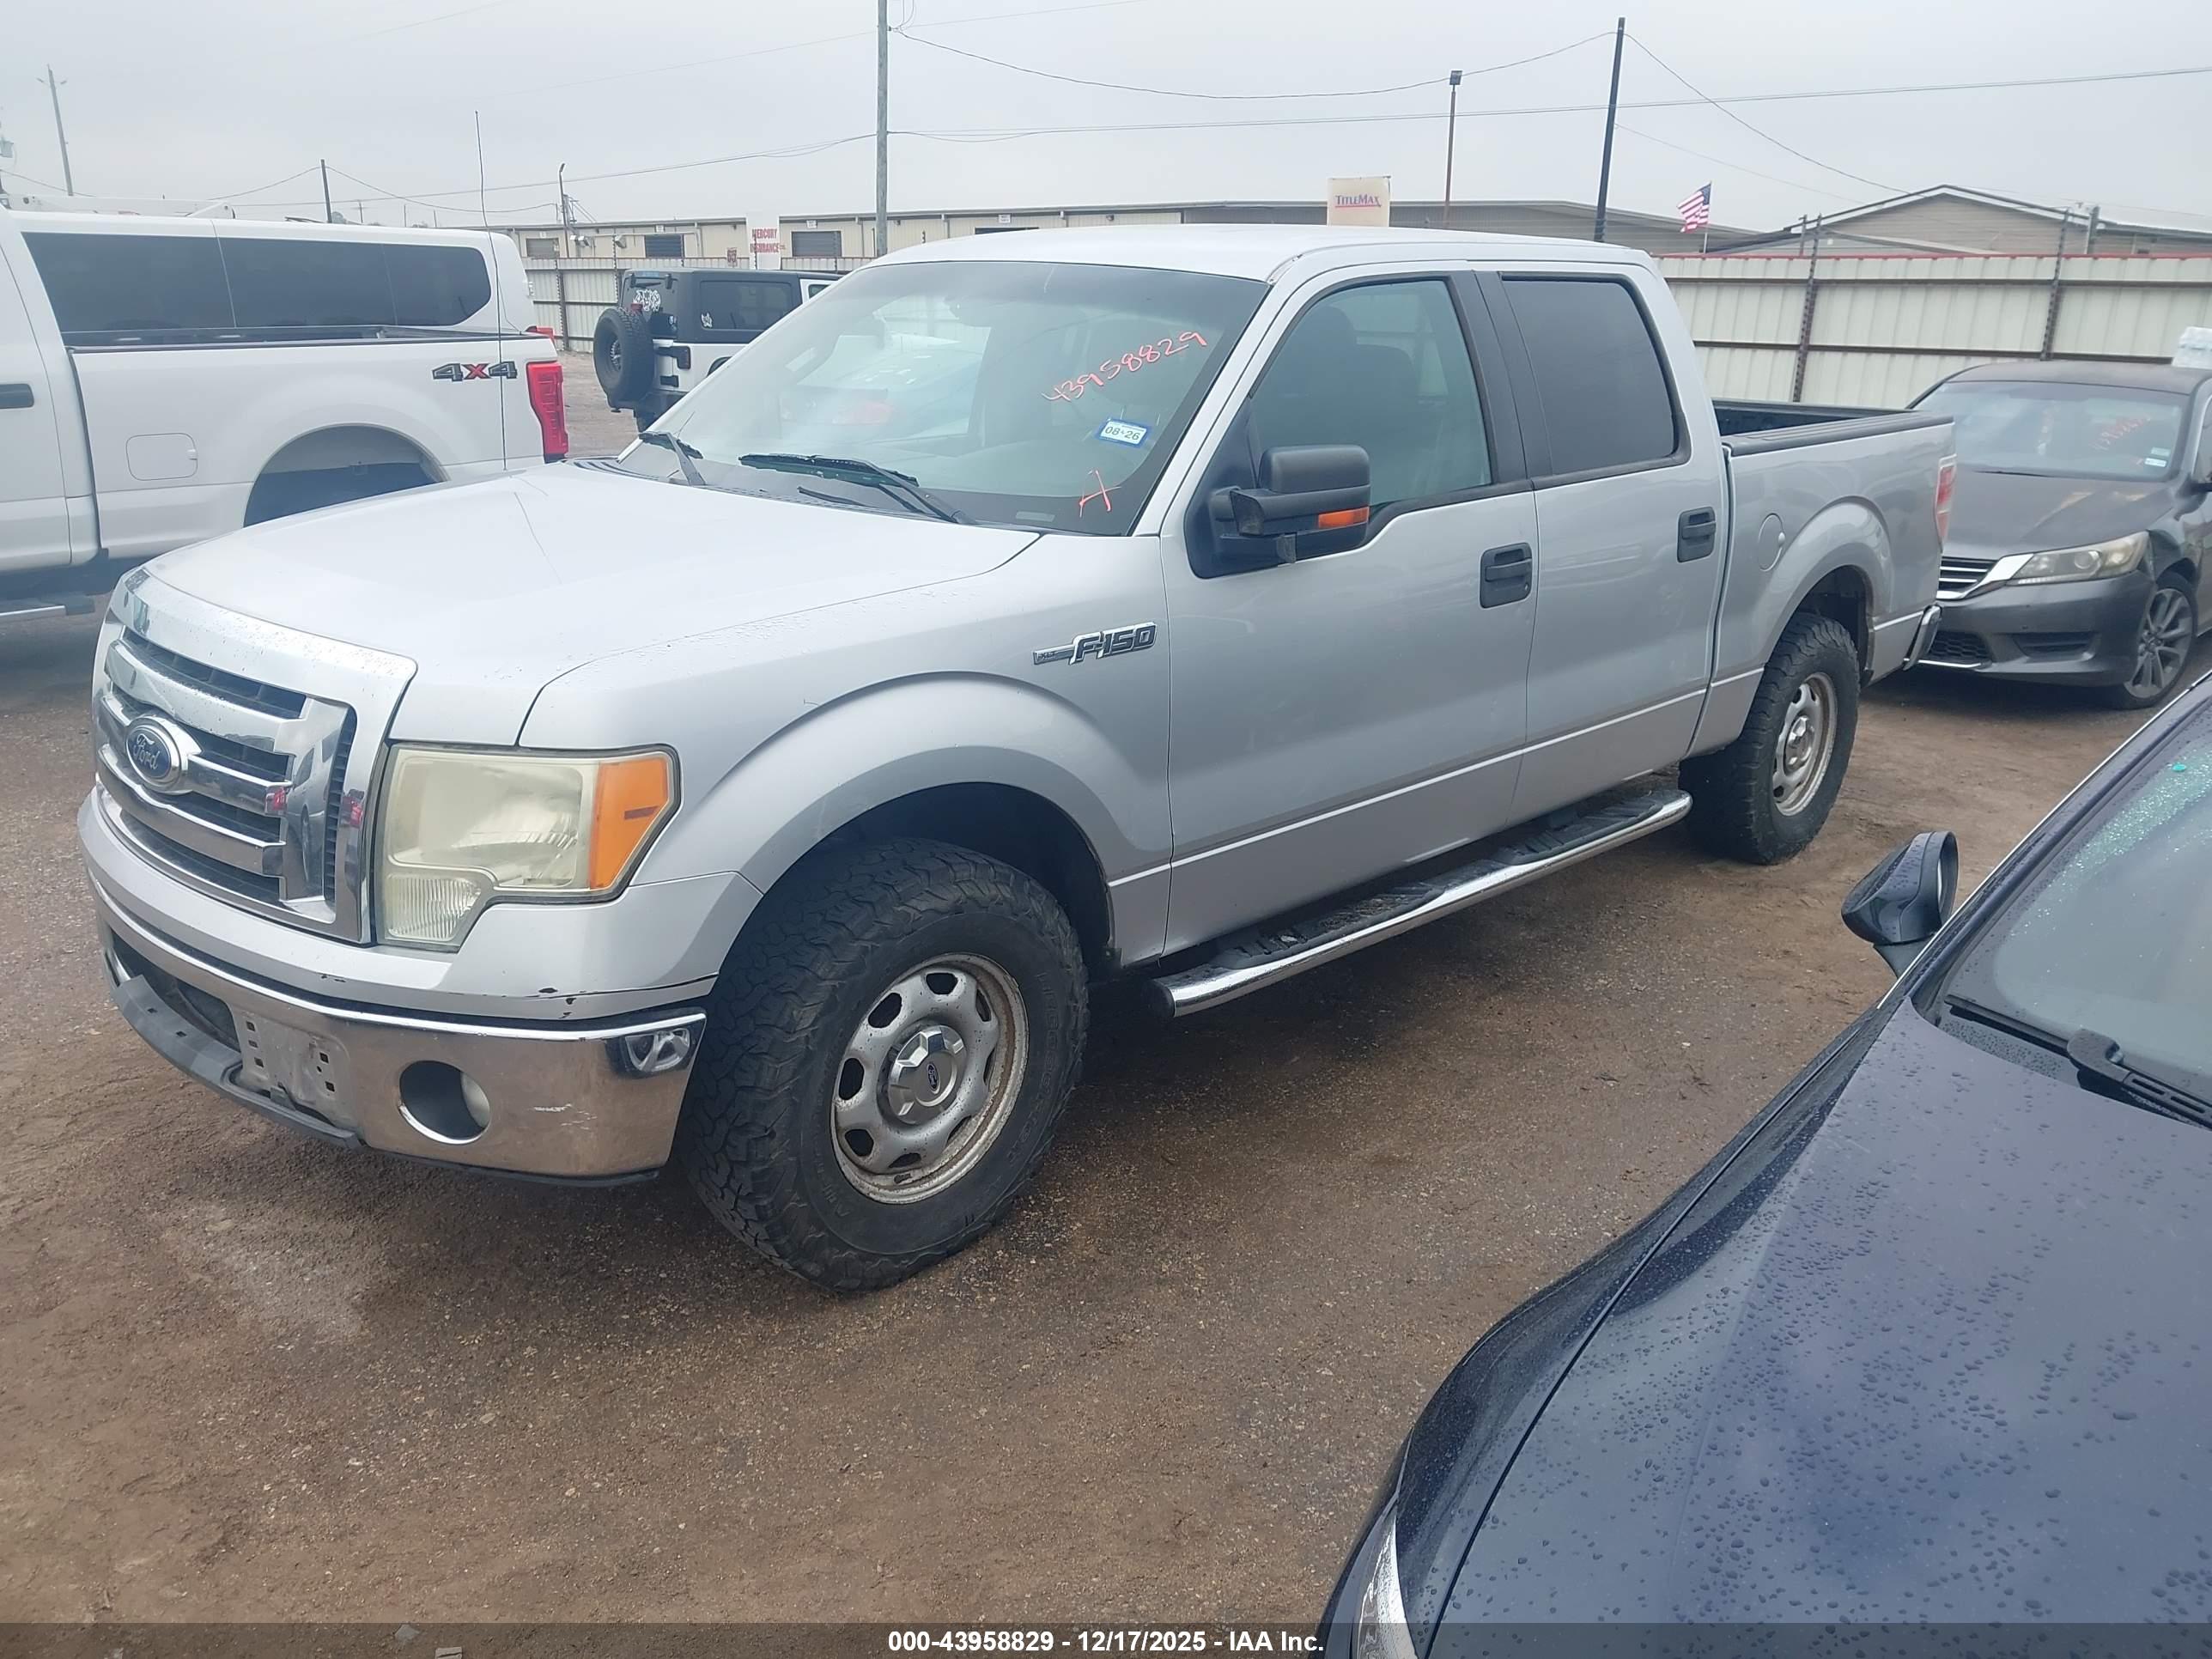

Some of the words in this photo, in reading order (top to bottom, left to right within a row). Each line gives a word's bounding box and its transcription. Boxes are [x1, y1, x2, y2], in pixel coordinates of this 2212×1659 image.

[1042, 331, 1207, 402] 43958829
[1069, 622, 1158, 665] F-150
[132, 732, 160, 770] Ford
